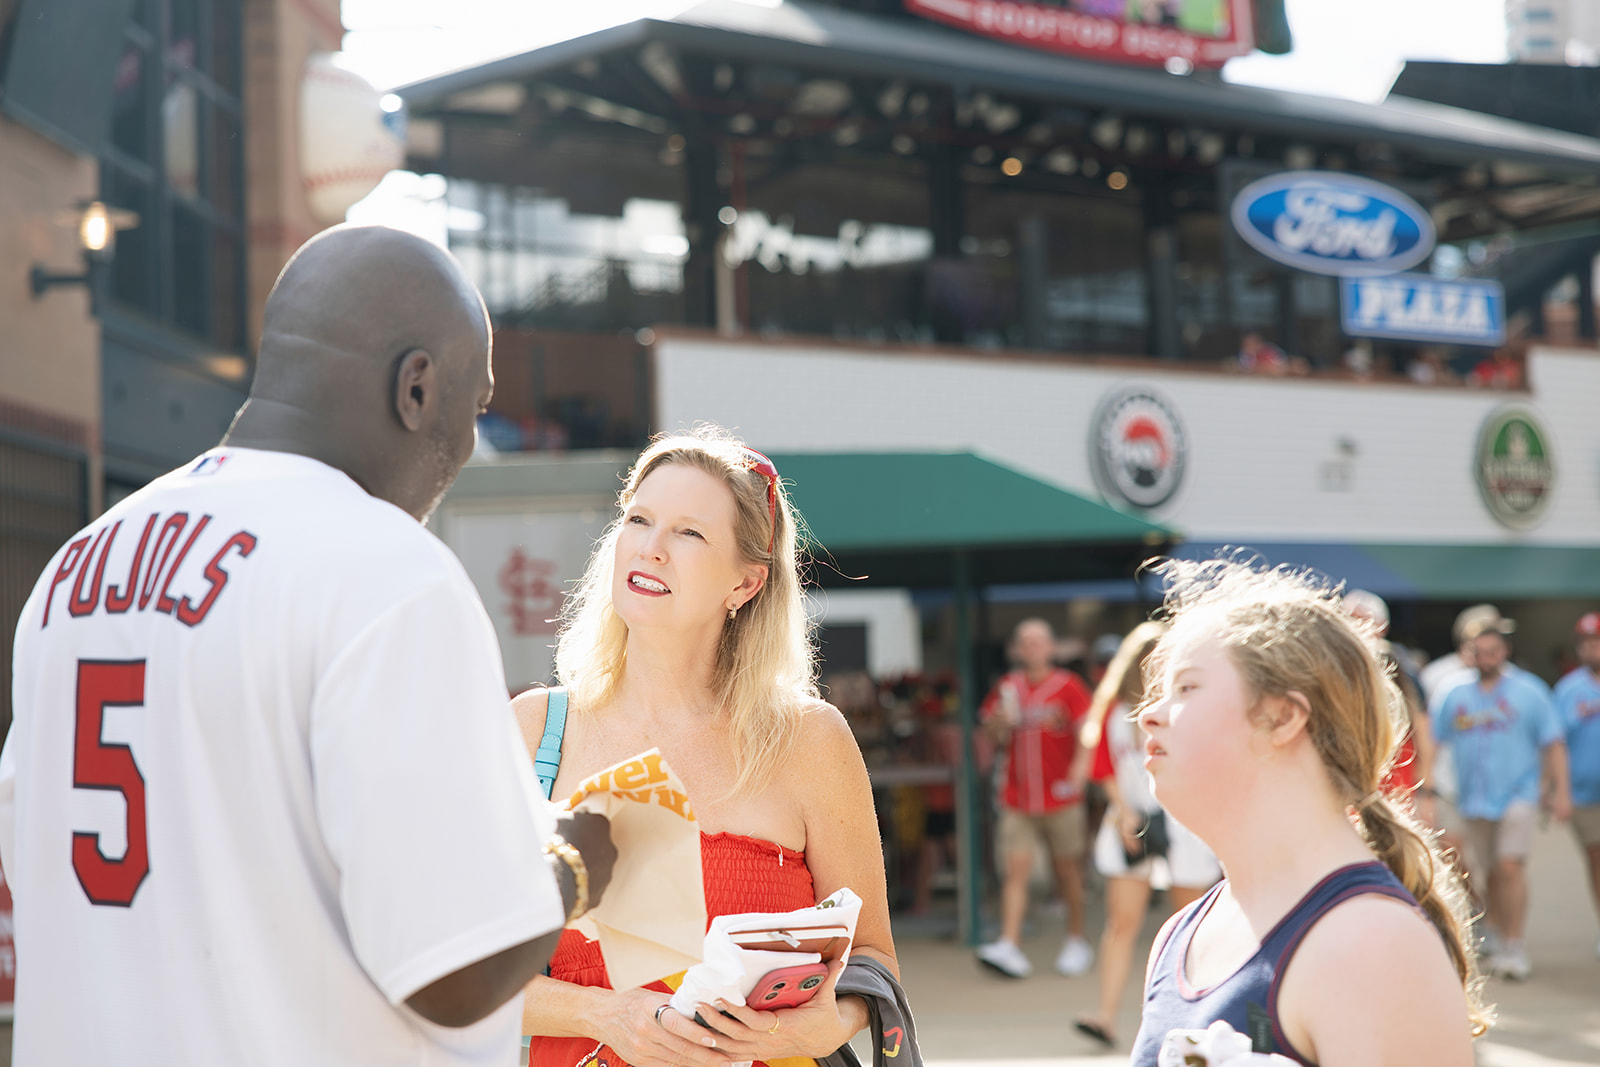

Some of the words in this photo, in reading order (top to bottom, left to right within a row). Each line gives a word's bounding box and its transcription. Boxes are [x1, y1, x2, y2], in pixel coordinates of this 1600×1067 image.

[1273, 180, 1397, 261] Ford
[1358, 279, 1489, 336] PLAZA
[41, 511, 257, 630] PUJOLS
[72, 658, 149, 907] 5
